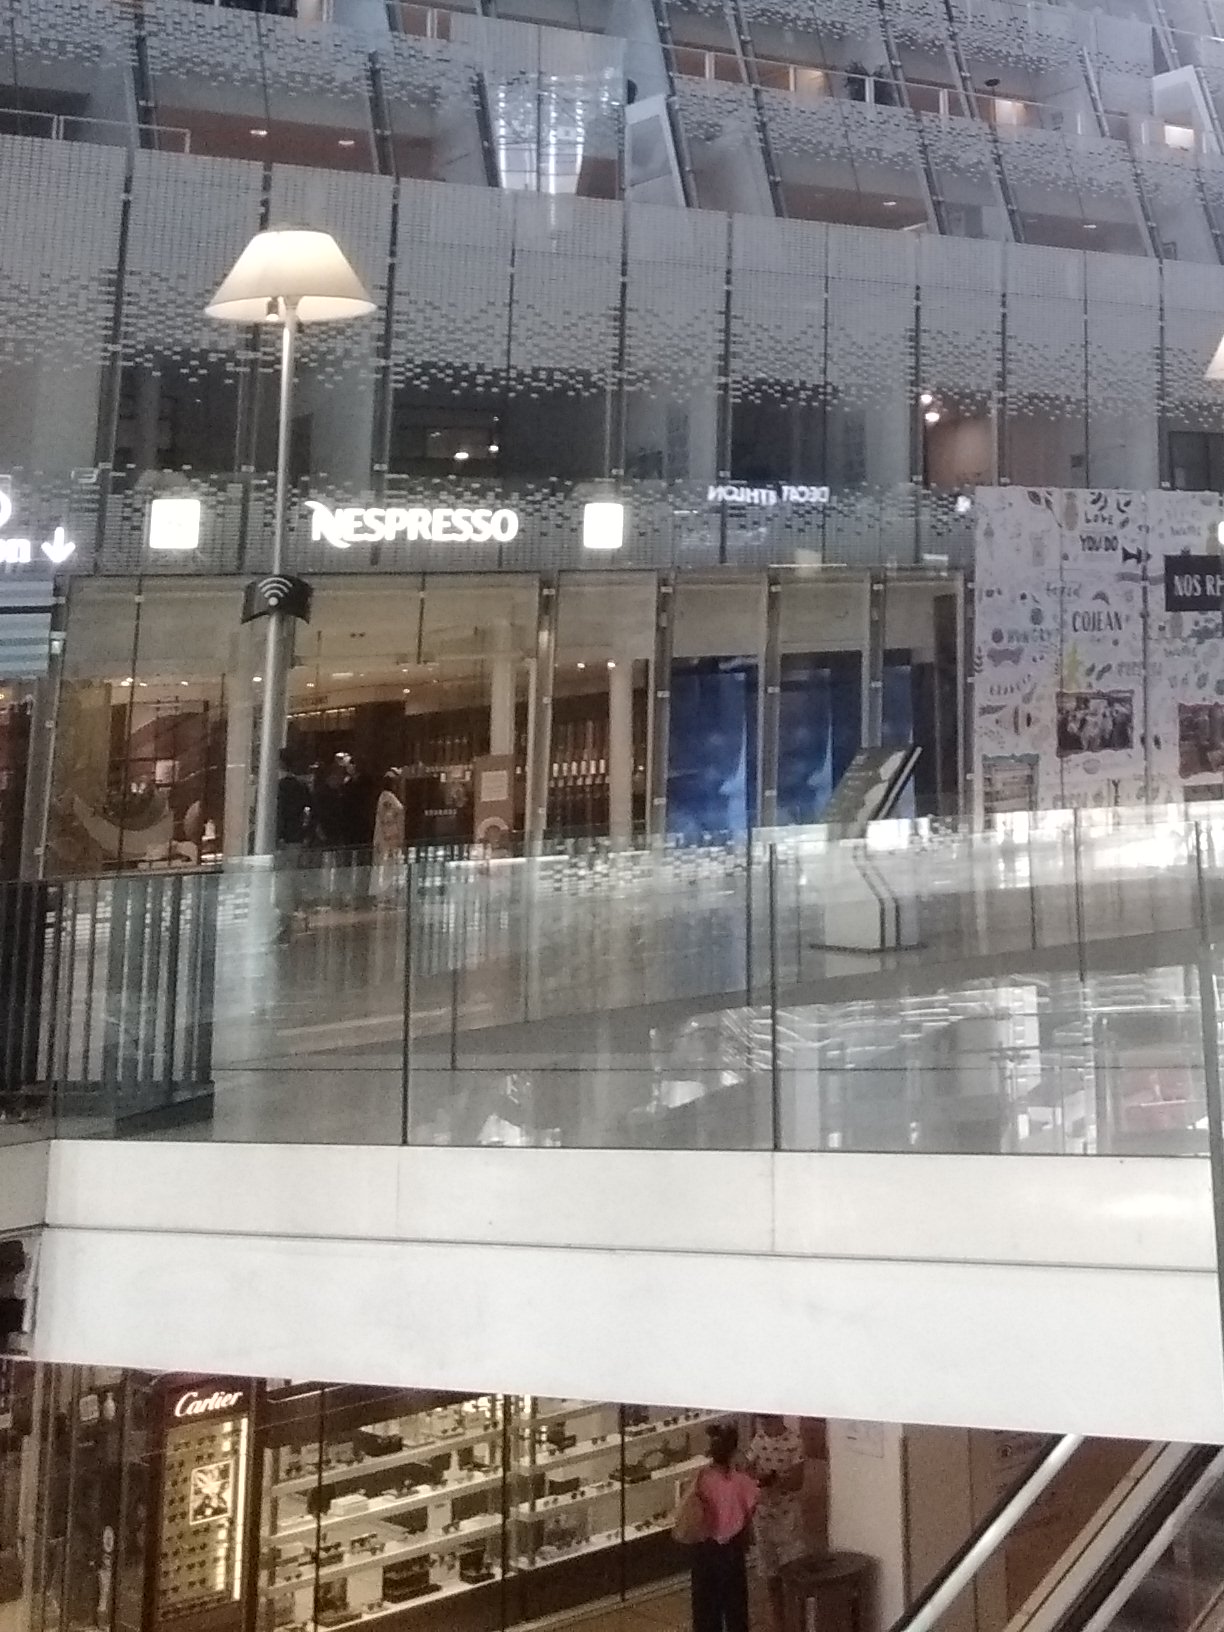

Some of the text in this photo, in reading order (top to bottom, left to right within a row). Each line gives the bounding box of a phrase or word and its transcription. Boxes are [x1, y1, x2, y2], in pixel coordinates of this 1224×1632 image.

[304, 501, 519, 548] NESPRESSO
[1174, 574, 1201, 596] NOS
[1072, 611, 1122, 632] COJEAN
[175, 1392, 243, 1417] Cartier
